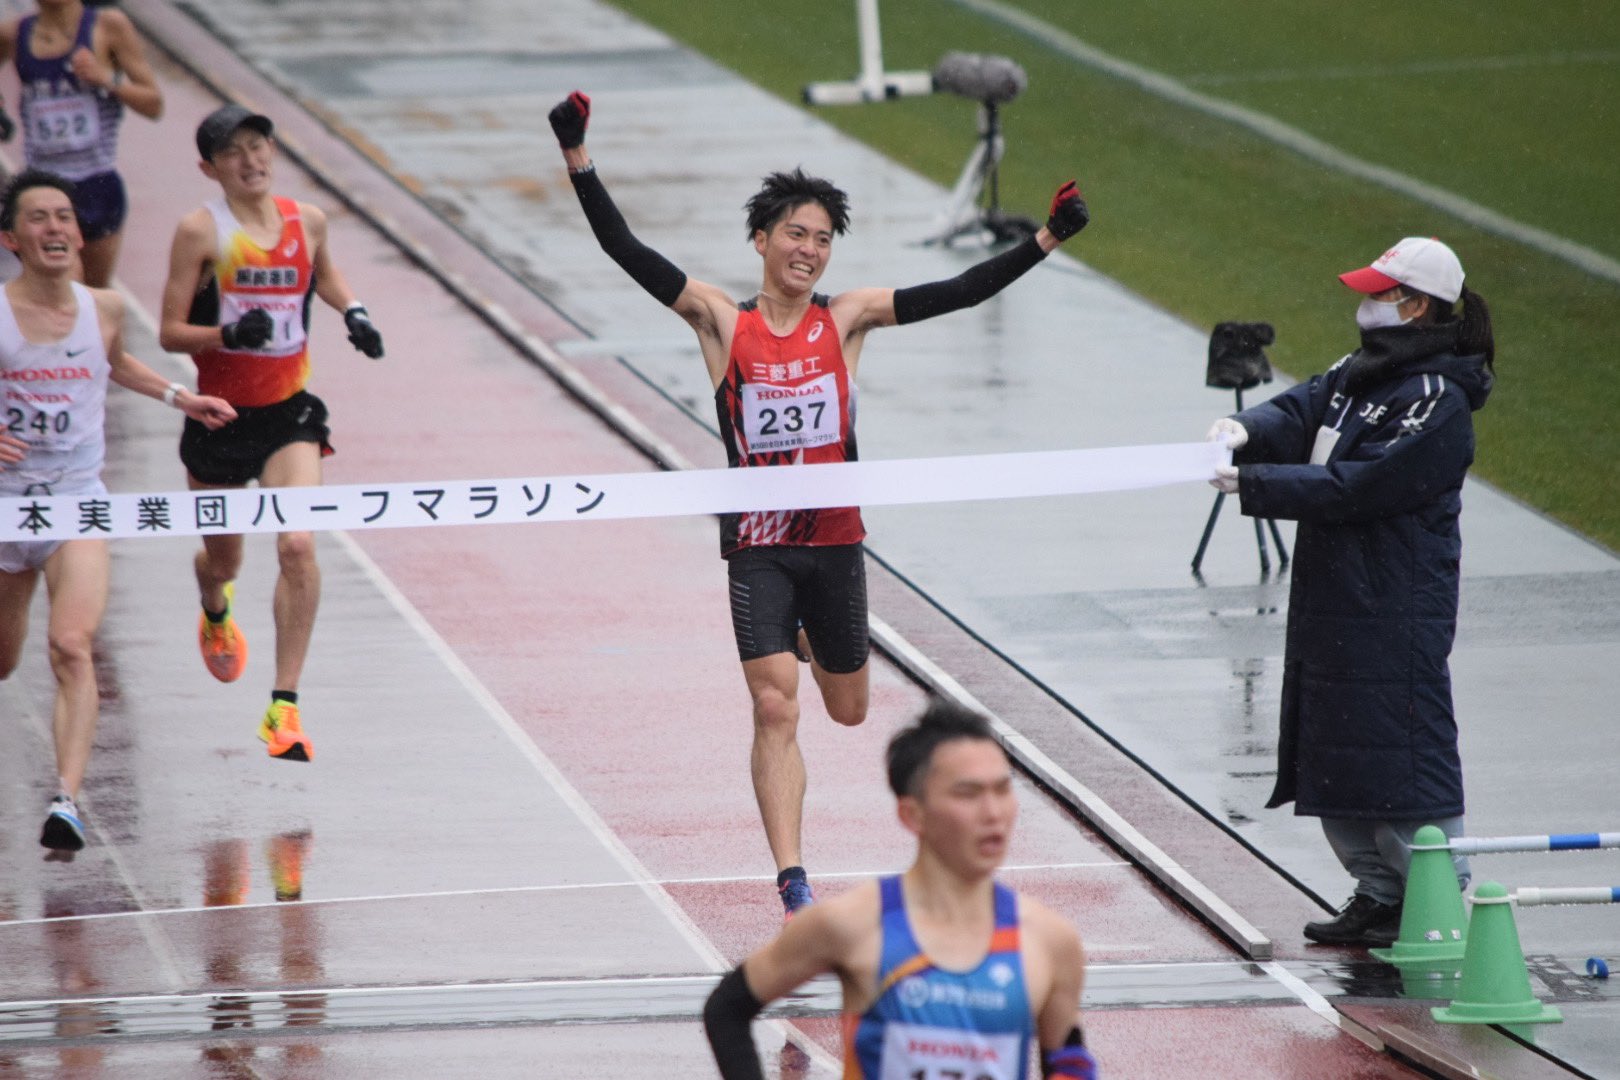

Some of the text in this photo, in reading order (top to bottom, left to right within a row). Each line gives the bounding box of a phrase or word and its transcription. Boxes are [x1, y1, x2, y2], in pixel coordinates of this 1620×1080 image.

[0, 367, 94, 382] HONDA
[752, 356, 822, 382] 三菱重工
[7, 391, 75, 404] HONDA
[756, 384, 824, 401] HONDA
[7, 407, 70, 434] 240
[758, 401, 827, 436] 237
[18, 483, 605, 535] 本実業団ハーフマラソン
